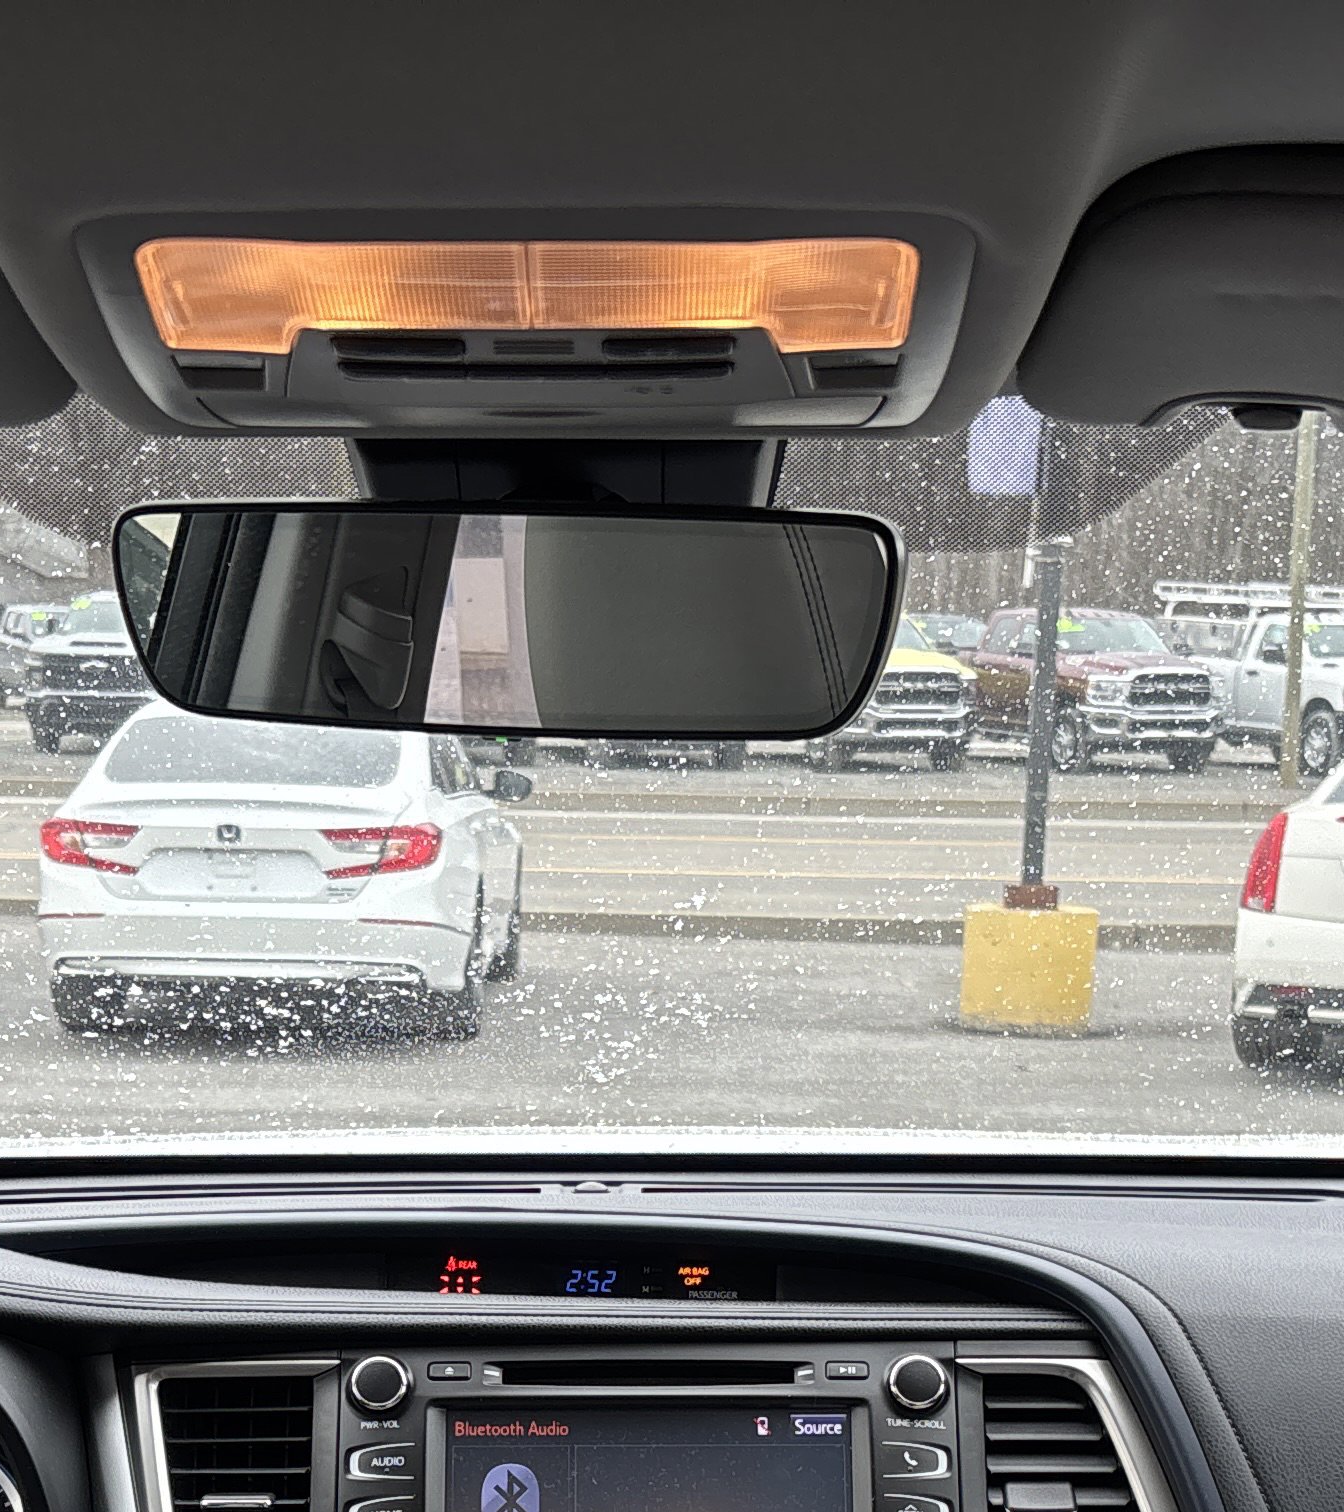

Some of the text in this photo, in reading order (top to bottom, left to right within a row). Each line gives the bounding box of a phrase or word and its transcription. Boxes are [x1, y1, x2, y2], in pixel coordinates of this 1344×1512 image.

[566, 1270, 616, 1293] 2:52
[684, 1277, 702, 1286] OFF
[688, 1290, 738, 1299] PASSENGER
[454, 1420, 569, 1437] Bluetooth Audio
[794, 1418, 843, 1435] Source
[370, 1456, 405, 1467] AUDIO
